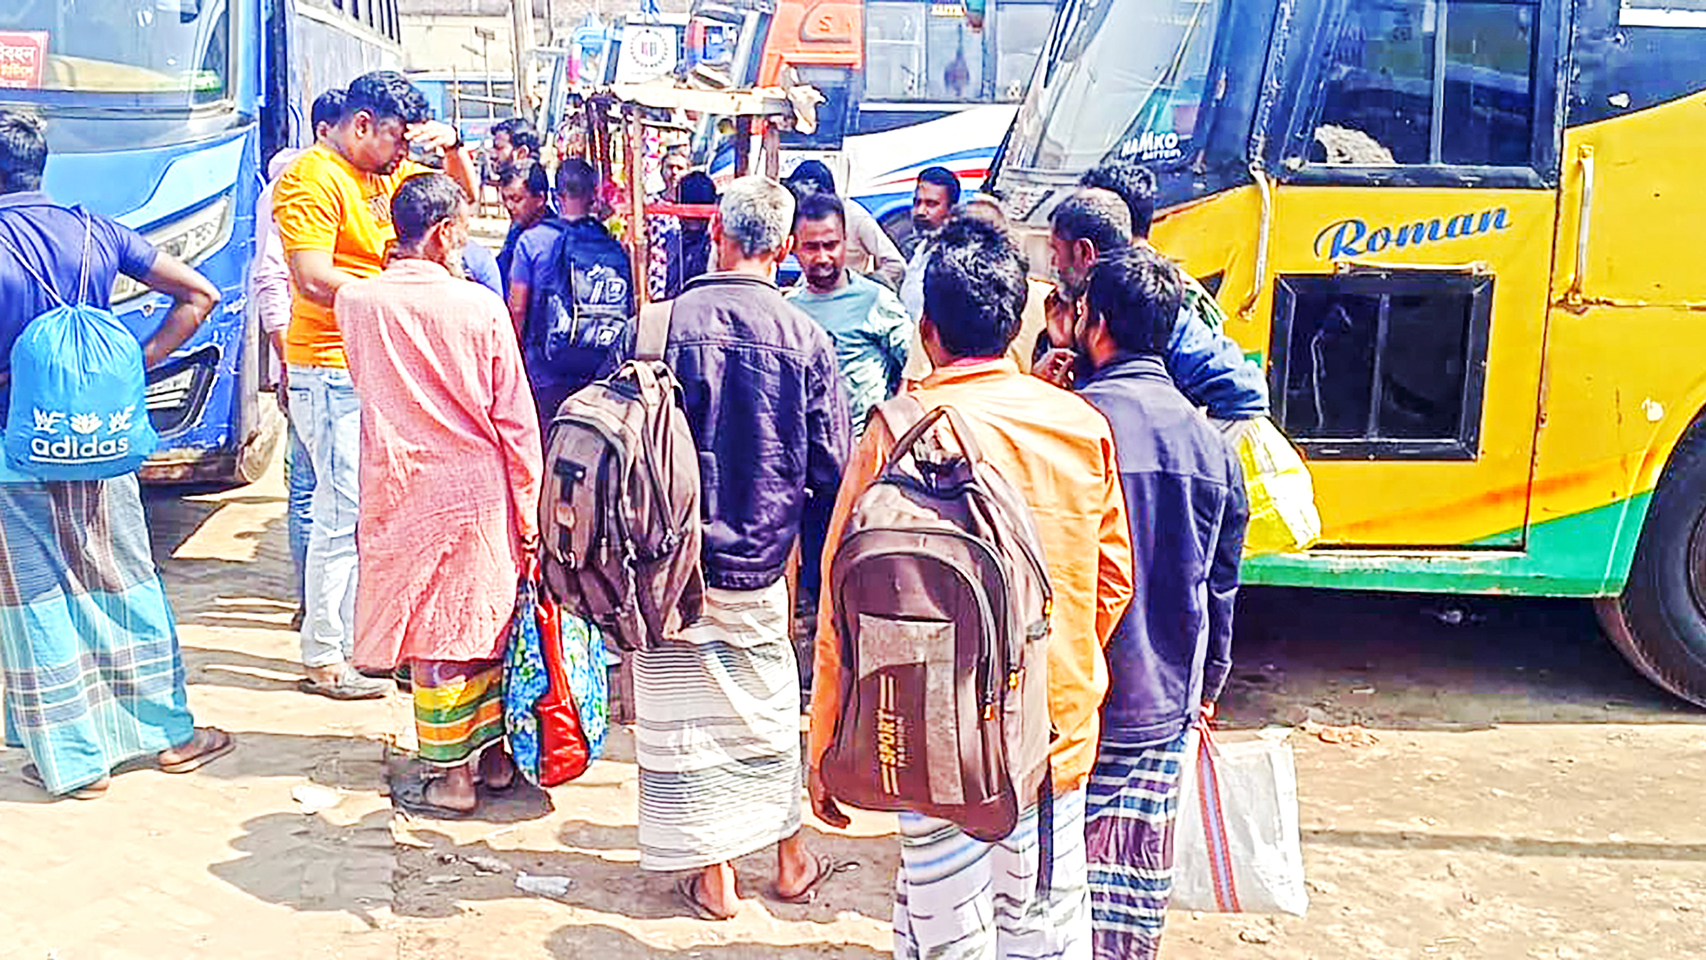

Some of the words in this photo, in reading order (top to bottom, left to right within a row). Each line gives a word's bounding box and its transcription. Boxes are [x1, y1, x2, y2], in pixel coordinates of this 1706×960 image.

[1314, 207, 1513, 259] Roman
[31, 435, 129, 458] adidas
[877, 709, 896, 766] SPORT
